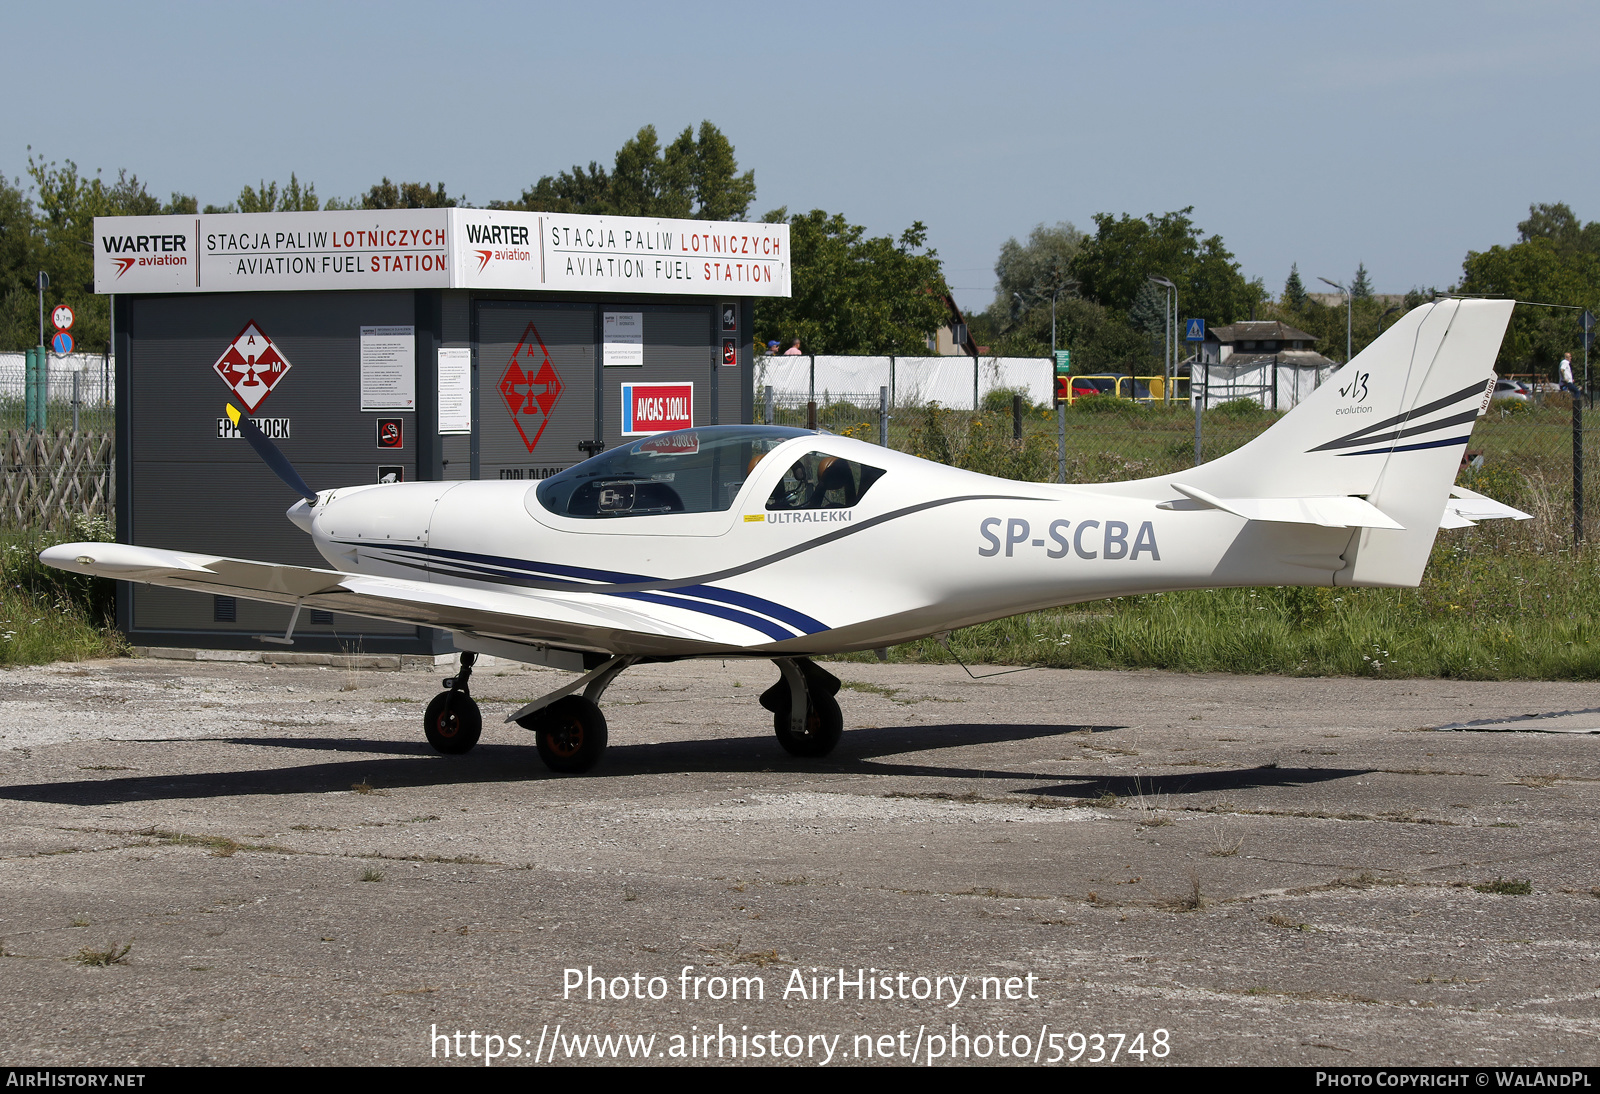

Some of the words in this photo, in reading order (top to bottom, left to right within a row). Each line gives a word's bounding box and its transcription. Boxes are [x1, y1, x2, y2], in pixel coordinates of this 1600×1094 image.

[103, 234, 187, 253] WARTER
[207, 232, 270, 251] STACJA
[276, 231, 328, 249] PALIW
[333, 228, 445, 248] LOTNICZYCH
[466, 223, 529, 246] WARTER
[552, 226, 616, 248] STACJA
[625, 230, 673, 251] PALIW
[681, 233, 780, 255] LOTNICZYCH
[138, 254, 187, 266] aviation
[494, 248, 530, 261] aviation
[236, 256, 316, 275] AVIATION
[322, 255, 365, 274] FUEL
[371, 254, 446, 272] STATION
[566, 257, 644, 278] AVIATION
[656, 260, 691, 280] FUEL
[704, 262, 771, 283] STATION
[247, 334, 256, 345] A
[526, 343, 535, 357] A
[222, 362, 231, 373] Z
[272, 361, 281, 373] M
[505, 380, 513, 395] Z
[548, 380, 556, 395] M
[1484, 379, 1496, 399] PUSH
[636, 397, 664, 421] AVGAS
[666, 396, 689, 421] 100LL
[1335, 404, 1373, 415] evolution
[1480, 399, 1489, 411] NO
[217, 418, 246, 438] EPP
[767, 510, 852, 524] ULTRALEKKI
[978, 516, 1161, 561] SP-SCBA
